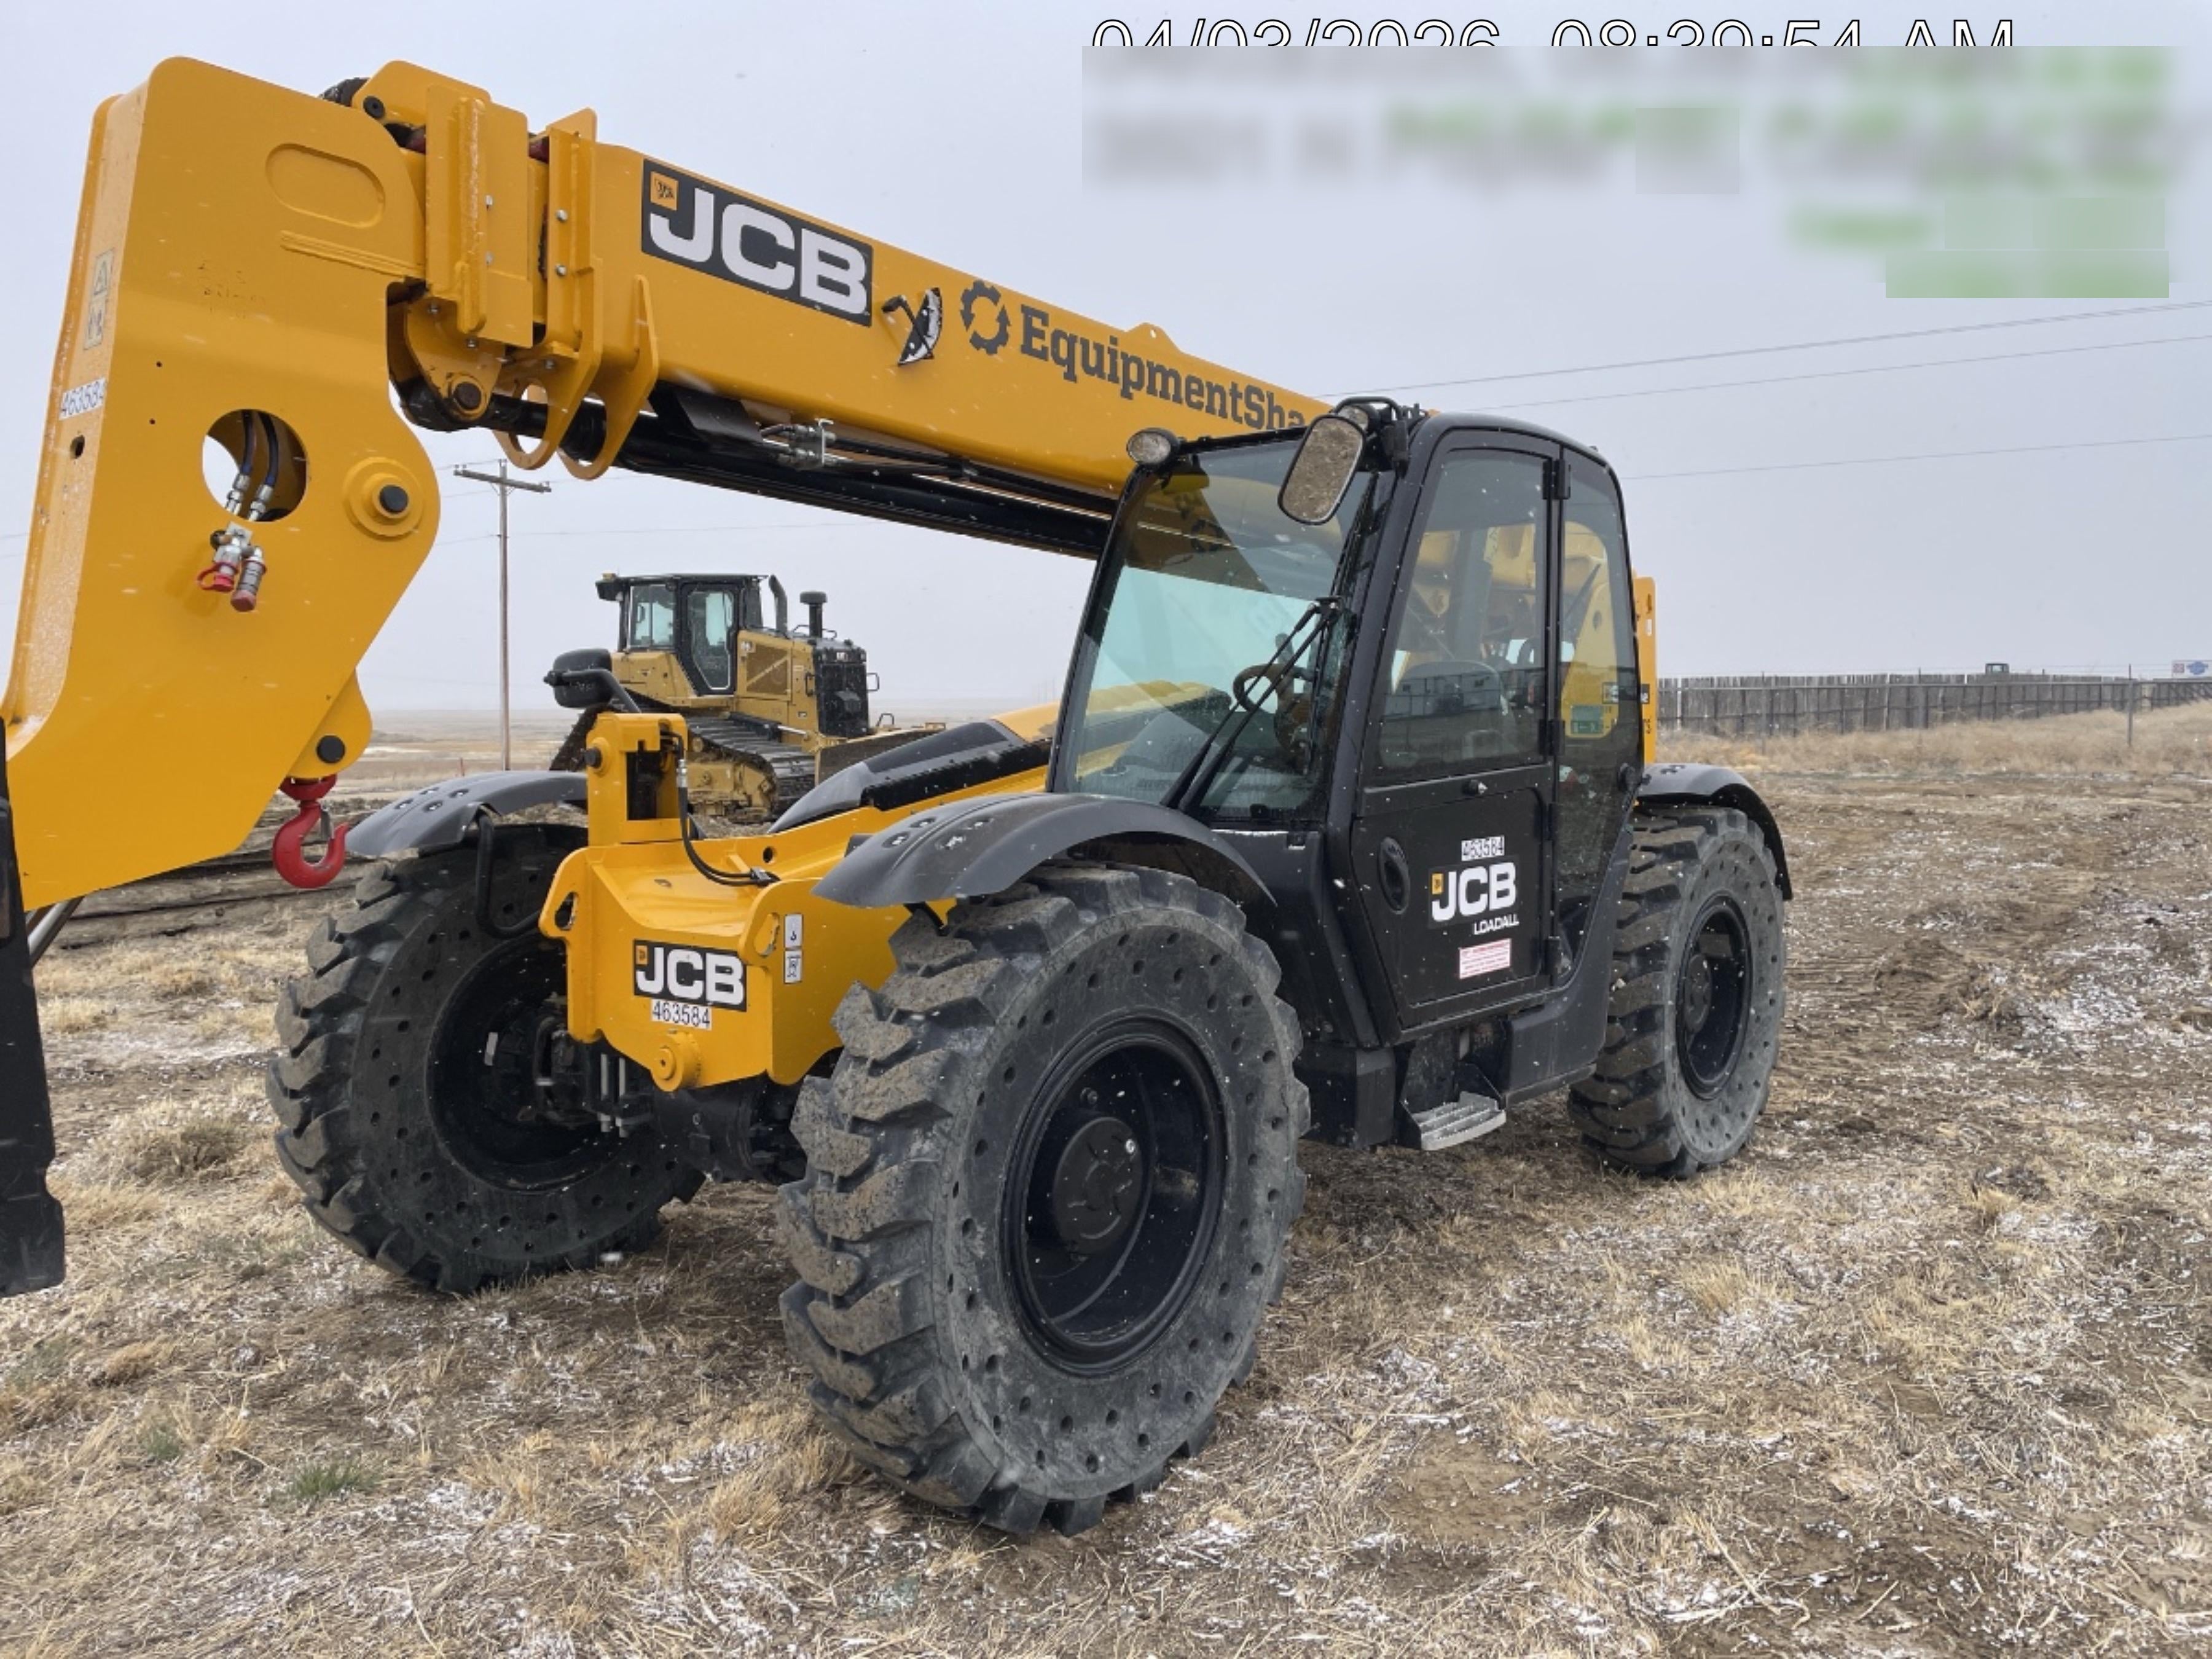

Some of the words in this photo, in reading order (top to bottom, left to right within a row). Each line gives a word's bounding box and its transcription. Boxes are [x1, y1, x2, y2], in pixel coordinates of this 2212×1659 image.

[649, 187, 868, 315] JCB
[1431, 861, 1517, 922] JCB
[1473, 913, 1520, 935] LOADALL
[635, 946, 744, 1005] JCB
[653, 1000, 710, 1029] 463584
